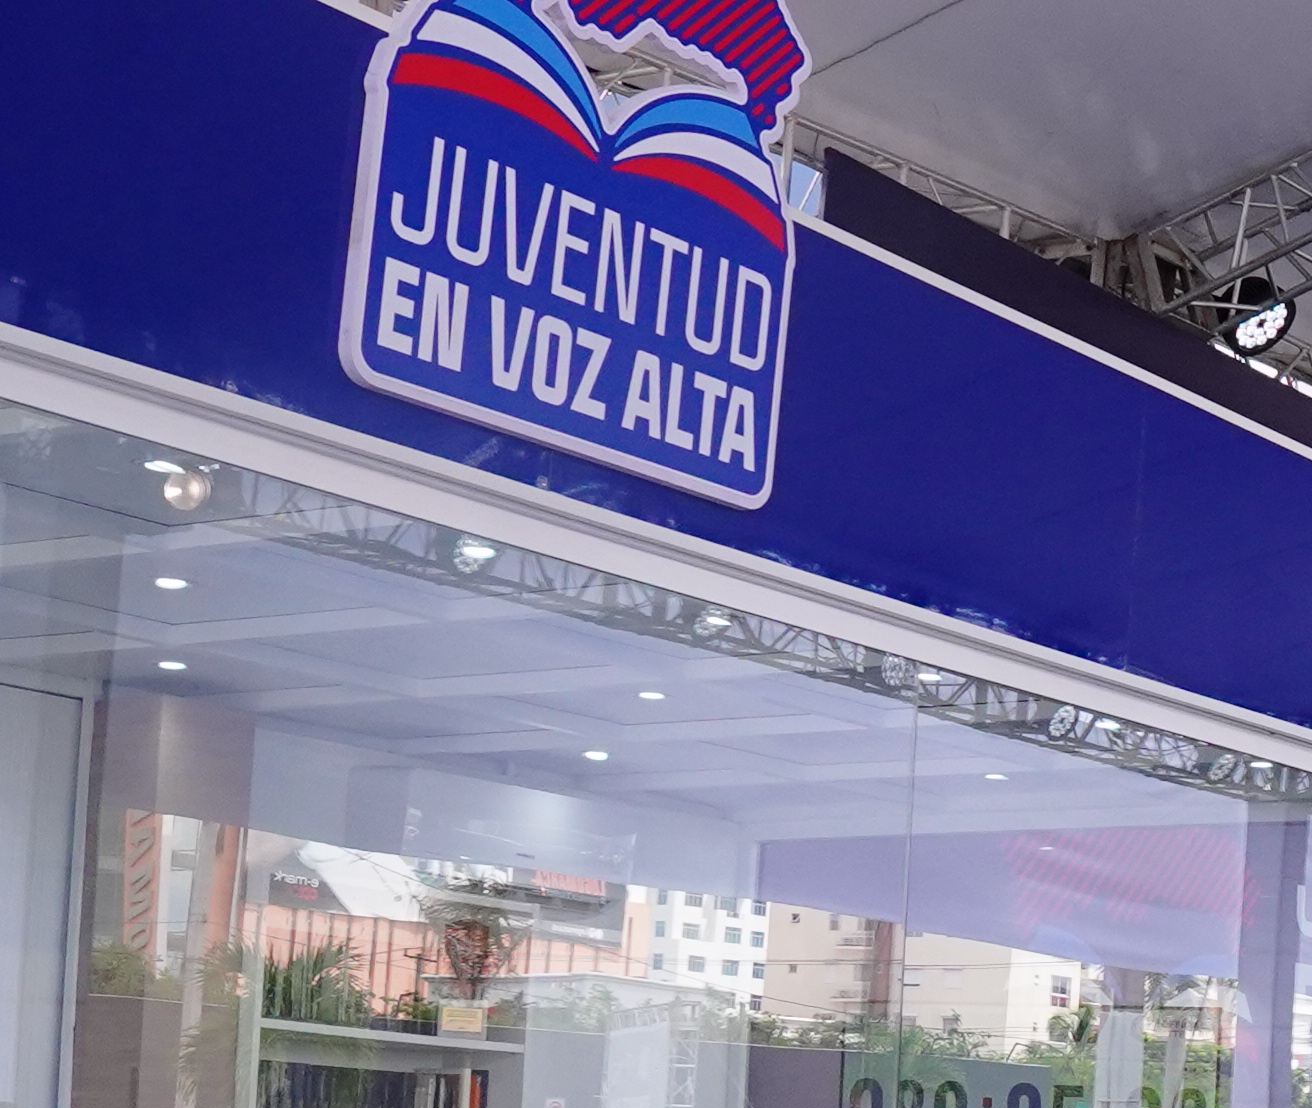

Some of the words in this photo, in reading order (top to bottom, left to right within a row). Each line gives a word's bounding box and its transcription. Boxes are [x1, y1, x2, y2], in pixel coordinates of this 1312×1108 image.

[377, 257, 469, 372] EN
[490, 296, 612, 421] VOZ
[622, 350, 756, 472] ALTA
[391, 136, 772, 371] JUVENTUD
